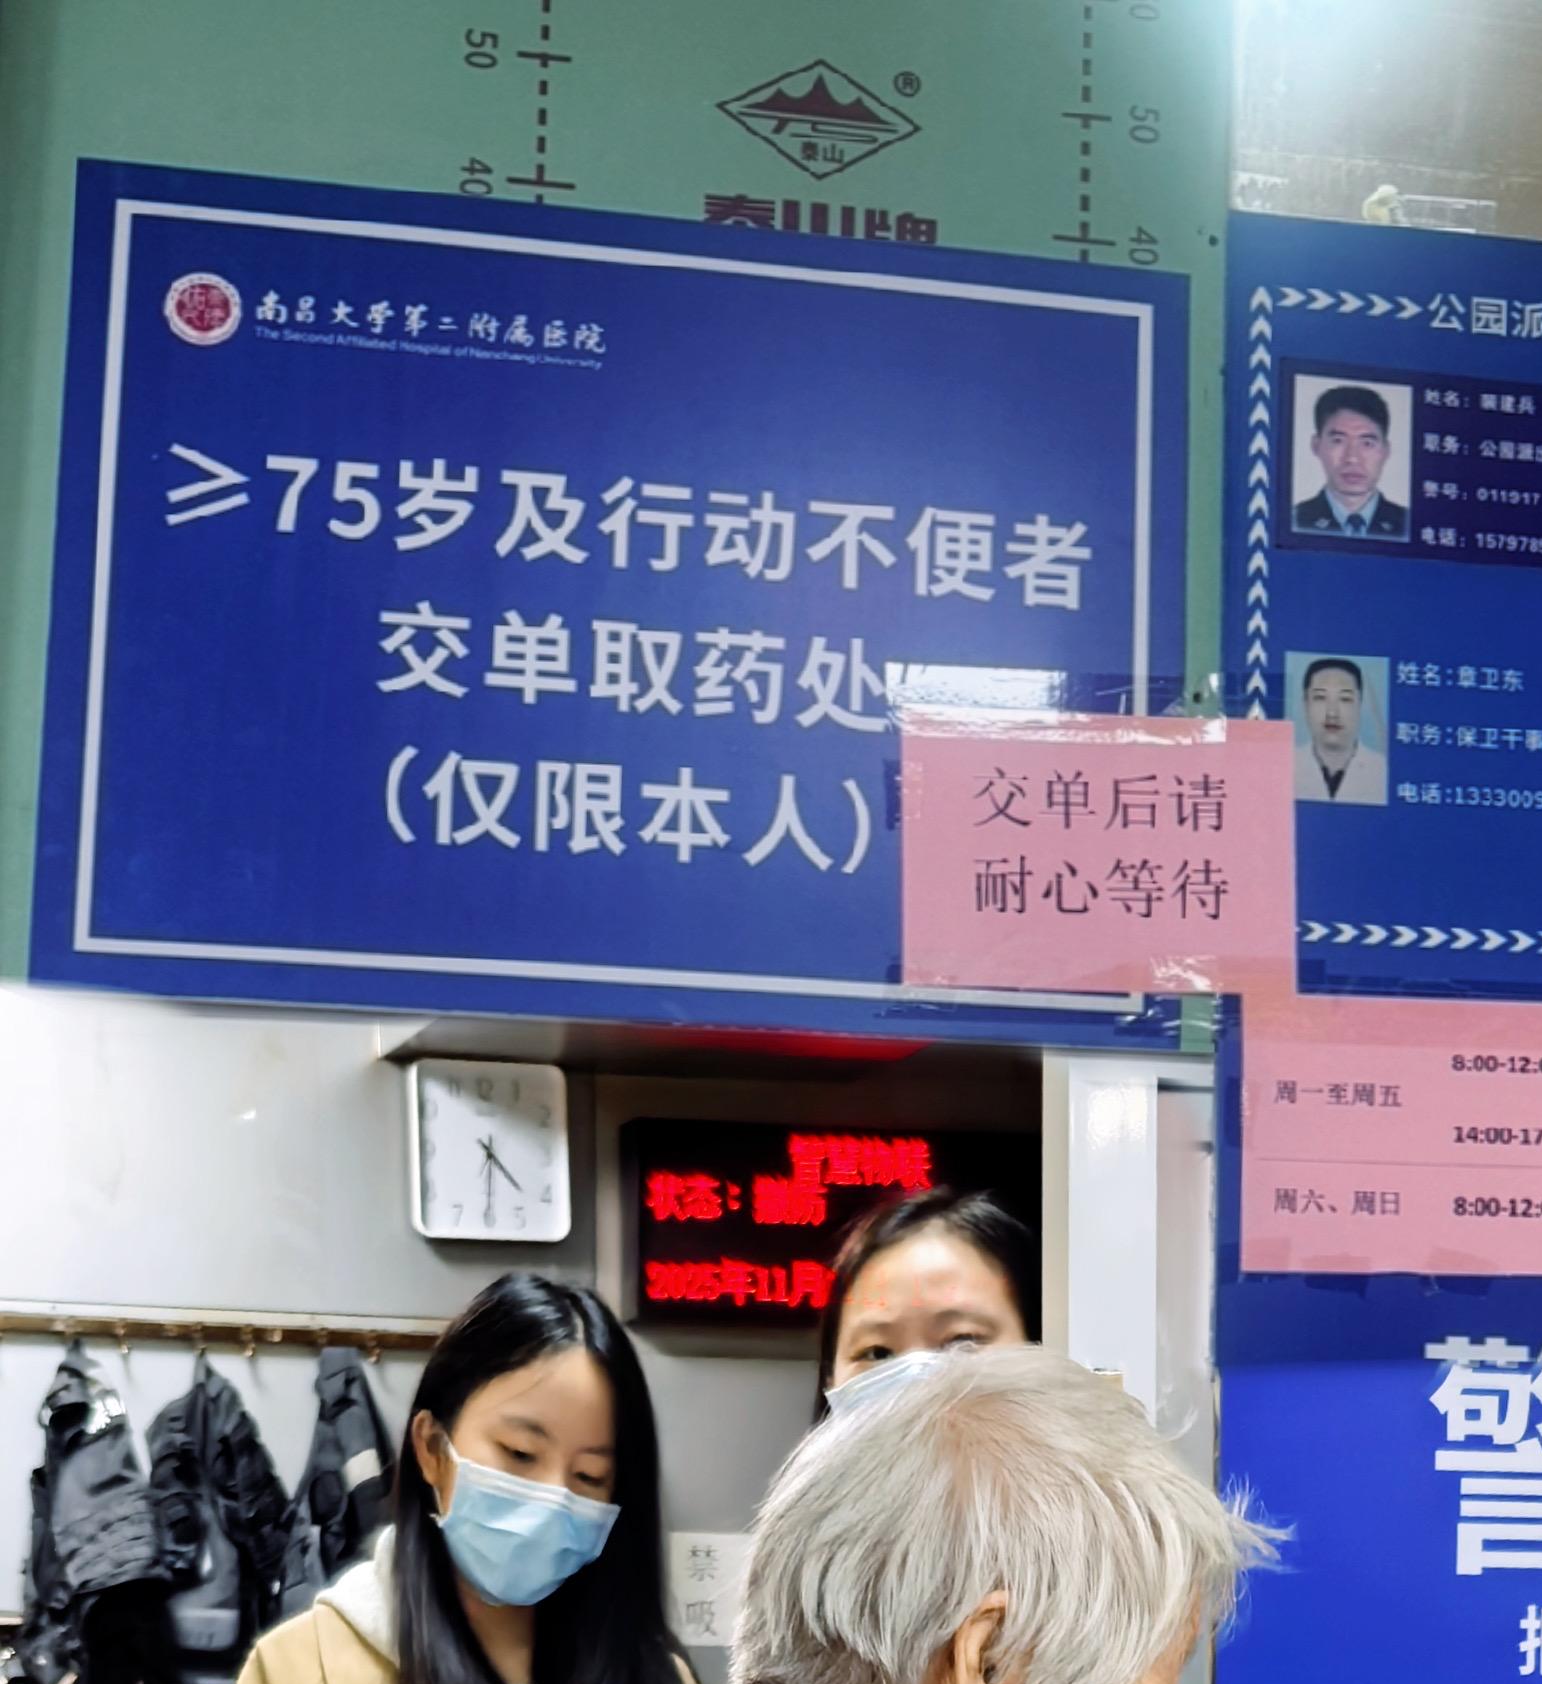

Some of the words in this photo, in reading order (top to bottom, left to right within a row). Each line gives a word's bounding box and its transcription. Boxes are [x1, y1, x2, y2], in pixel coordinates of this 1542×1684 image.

[465, 28, 498, 69] 50
[1129, 105, 1160, 144] 50
[802, 141, 845, 165] 泰山
[460, 157, 494, 195] 40
[1128, 226, 1160, 265] 40
[256, 289, 606, 354] 南昌大学第二附属医院
[256, 325, 280, 339] The
[282, 328, 336, 345] Second
[398, 339, 452, 357] Hospital
[165, 443, 1093, 610] ≥75岁及行动不便者
[376, 600, 888, 734] 交单取药处
[384, 743, 873, 873] （仅限本人）
[973, 767, 1228, 832] 交单后请
[973, 855, 1229, 920] 耐心等待
[1274, 1079, 1403, 1108] 周一至周五
[1273, 1187, 1401, 1217] 周六、周日
